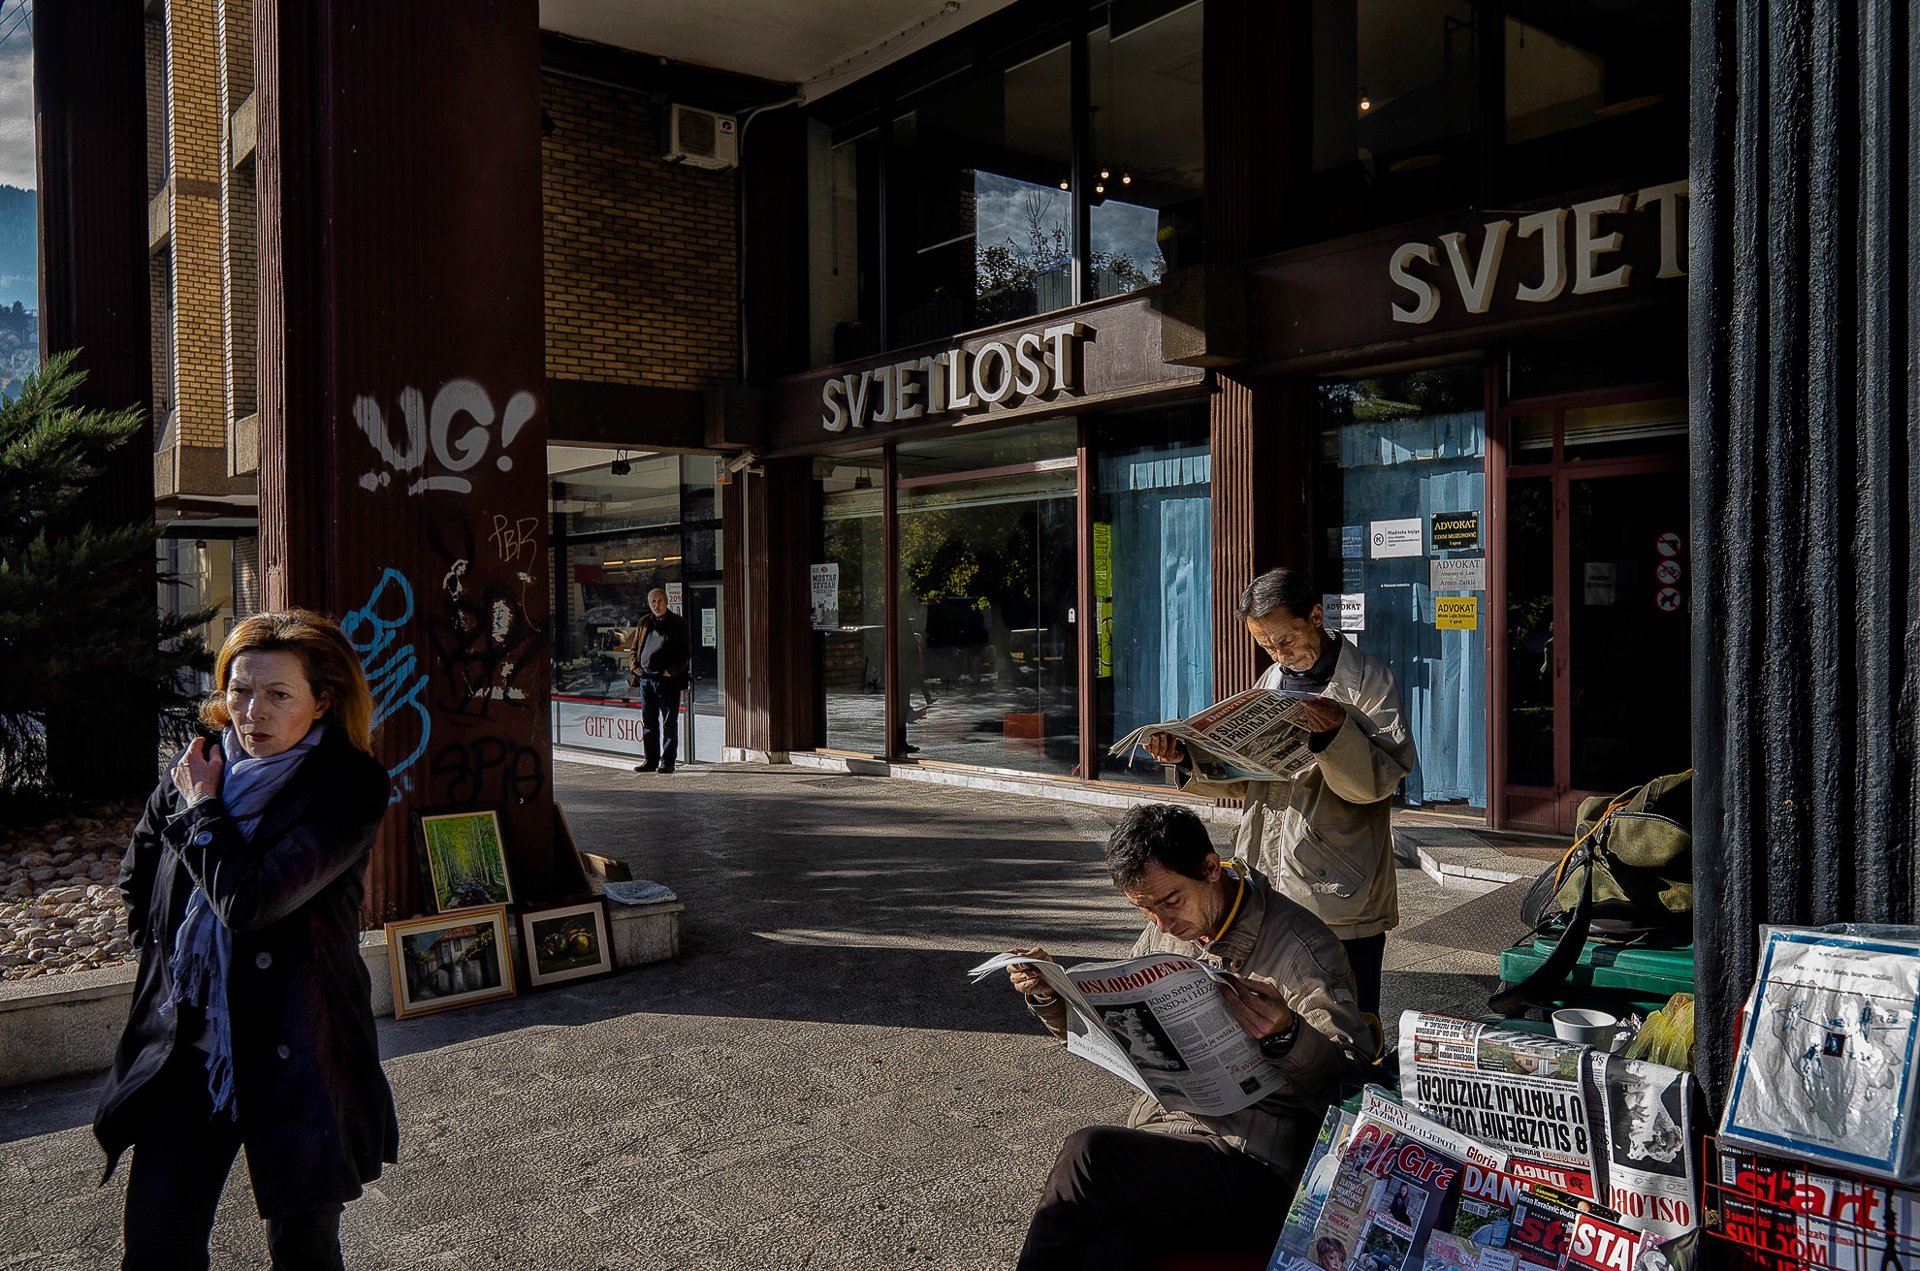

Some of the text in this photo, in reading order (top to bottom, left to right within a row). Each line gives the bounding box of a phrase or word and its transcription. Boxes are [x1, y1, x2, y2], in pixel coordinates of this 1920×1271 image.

[1389, 179, 1688, 324] SVJET
[822, 322, 1084, 433] SVJETLOST
[1434, 520, 1476, 531] ADVOKAT
[1436, 560, 1480, 570] ADVOKAT
[812, 574, 837, 582] MOSTAR
[1326, 603, 1361, 611] ADVOKAT
[1437, 604, 1475, 613] ADVOKAT
[584, 715, 615, 740] GIFT
[1149, 977, 1207, 1006] Klub Srba po
[1153, 998, 1187, 1015] SNSD-a
[1495, 1085, 1568, 1121] PRATNJI
[1570, 1095, 1585, 1124] U
[1479, 1111, 1572, 1152] SLUŽBENIH
[1574, 1126, 1588, 1155] 8
[1466, 1146, 1498, 1170] Gloria
